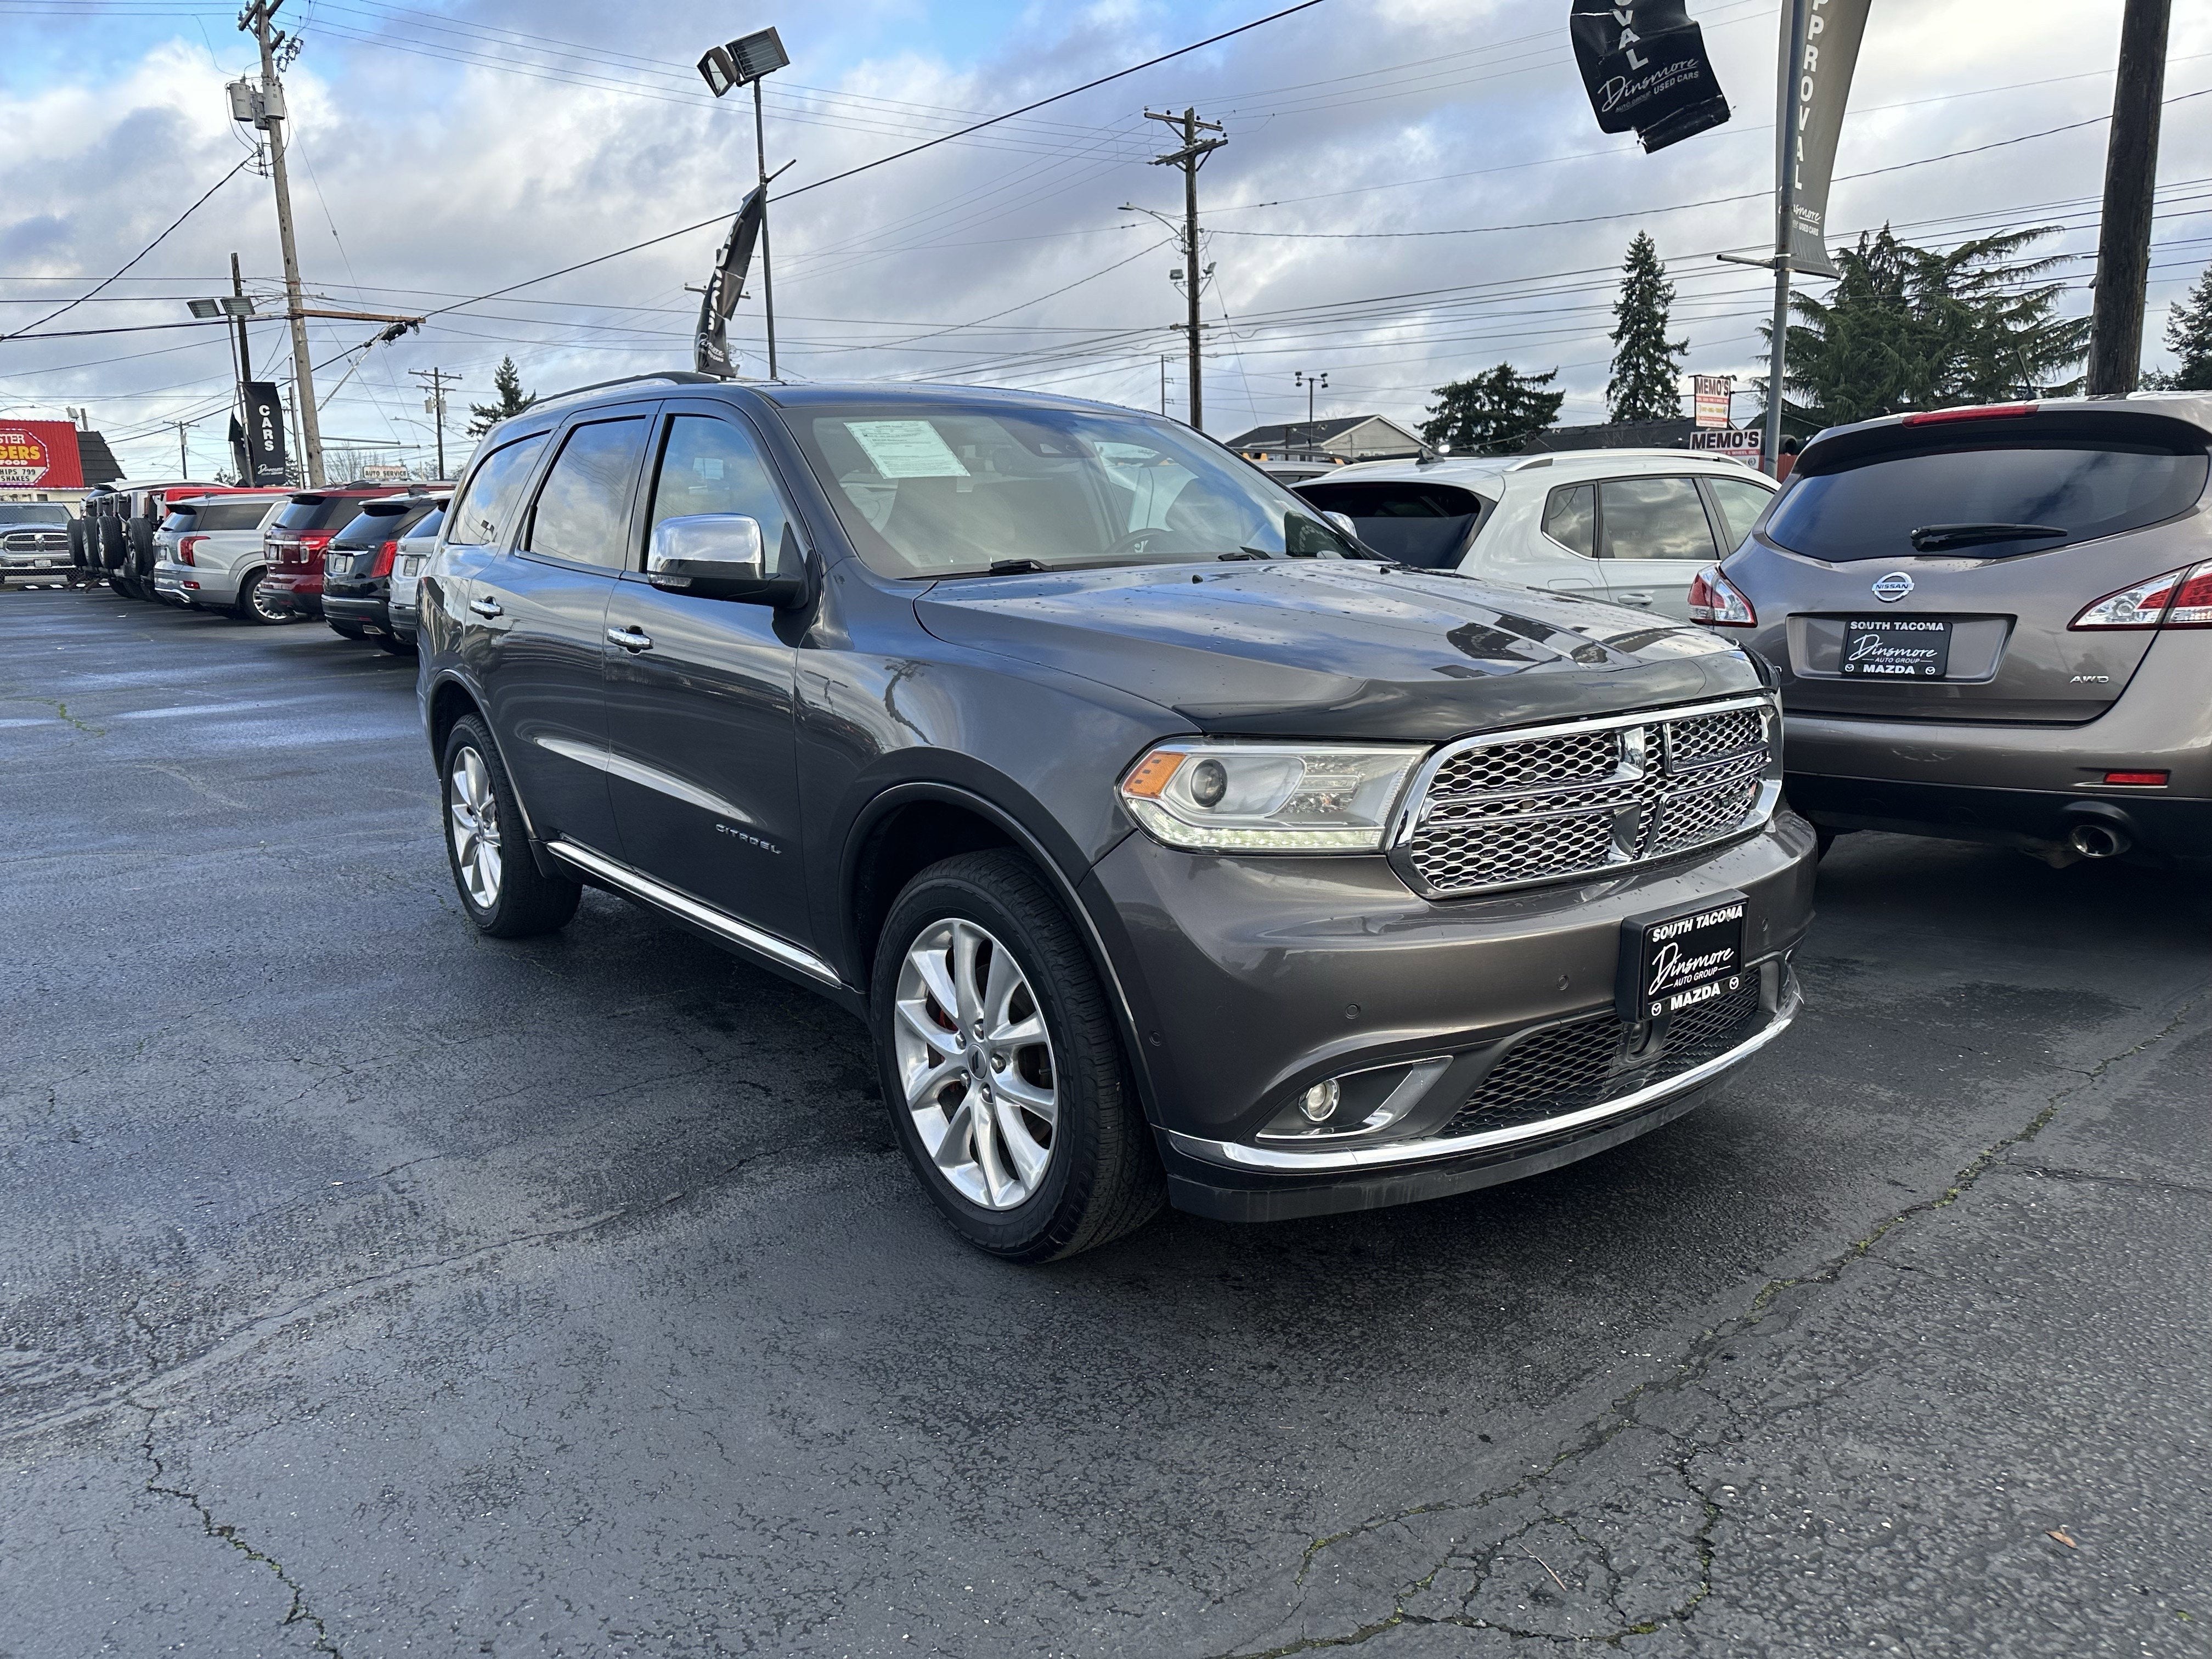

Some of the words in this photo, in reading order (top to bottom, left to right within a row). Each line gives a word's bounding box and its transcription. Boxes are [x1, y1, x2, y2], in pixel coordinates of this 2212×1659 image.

[1613, 0, 1649, 70] VAL
[1597, 58, 1700, 112] Dinsmore
[1654, 77, 1675, 94] USED
[1677, 71, 1699, 83] CARS
[1696, 378, 1729, 396] MEMO'S
[259, 405, 274, 452] CARS
[1691, 431, 1759, 449] MEMO'S
[0, 445, 41, 460] GERS
[1850, 621, 1891, 630] SOUTH
[1894, 622, 1944, 631] TACOMA
[1848, 634, 1938, 661] Dinsmore
[1863, 664, 1915, 675] MAZDA
[2069, 675, 2109, 684] AWD
[715, 823, 782, 855] CITADEL
[1652, 918, 1694, 943] SOUTH
[1696, 905, 1743, 929] TACOMA
[1648, 942, 1734, 996] Dinsmore
[1673, 974, 1692, 988] AUTO
[1694, 967, 1718, 981] GROUP
[1671, 982, 1721, 1011] MAZDA
